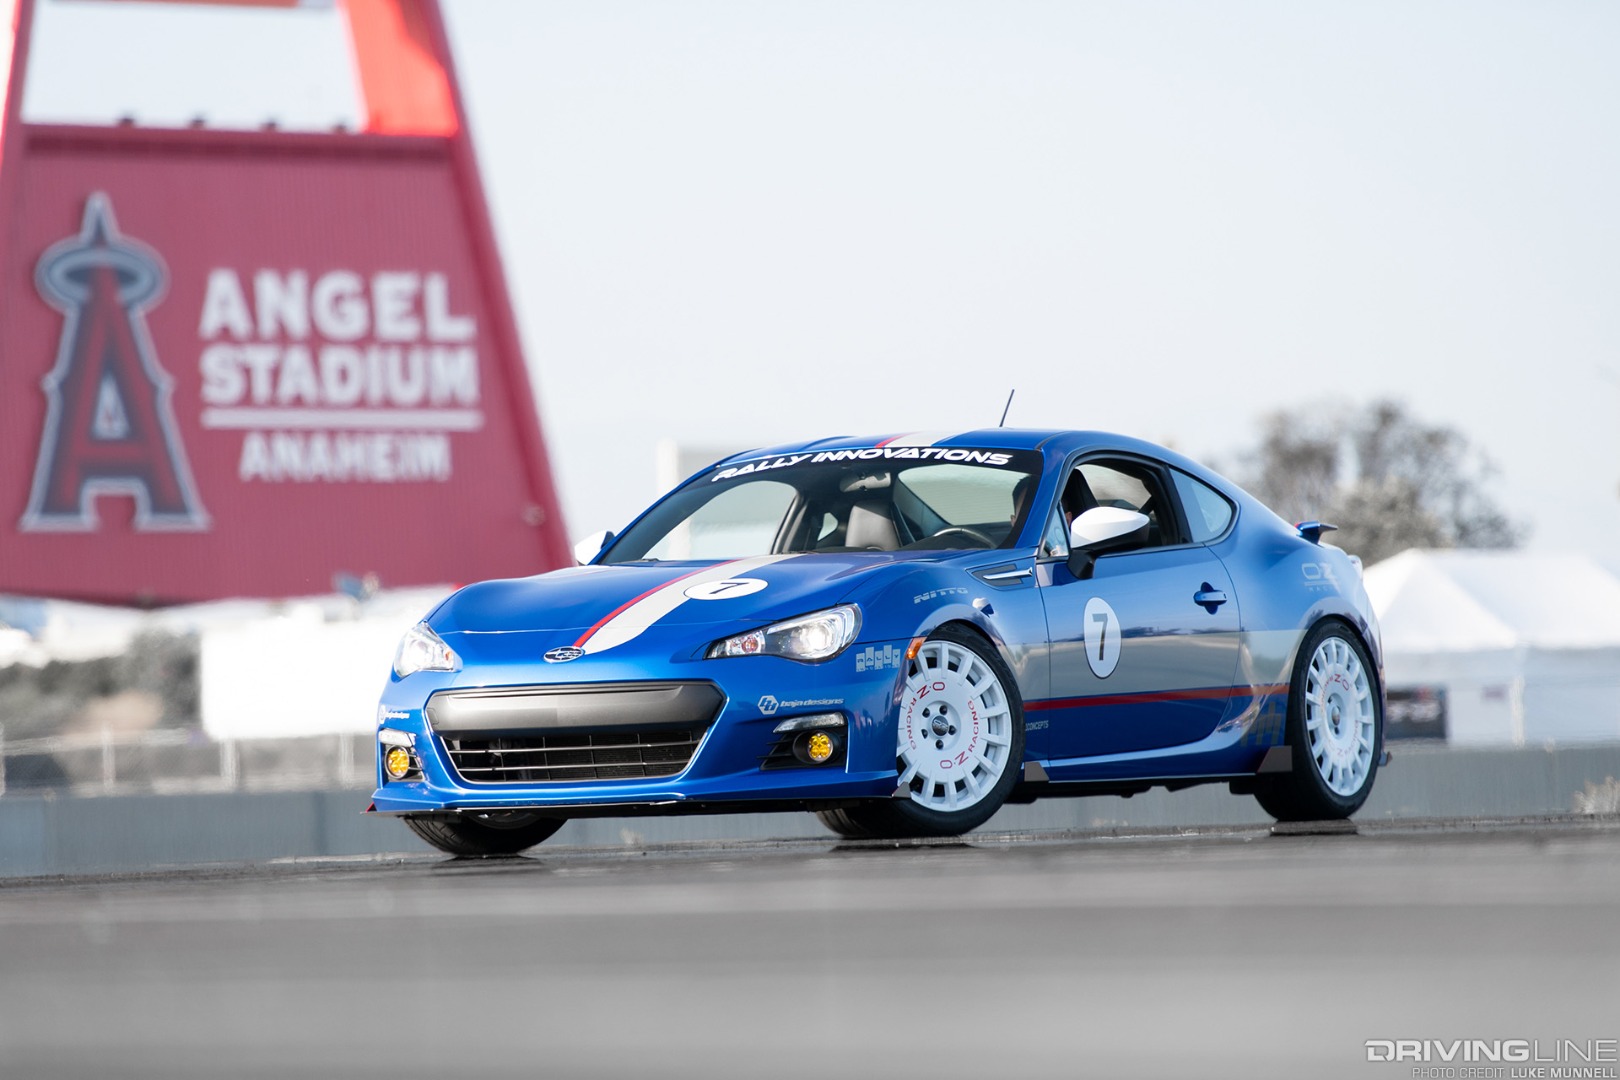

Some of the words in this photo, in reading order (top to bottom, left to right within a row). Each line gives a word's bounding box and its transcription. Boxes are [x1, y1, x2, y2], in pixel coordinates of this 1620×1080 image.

[200, 267, 477, 341] ANGEL
[200, 344, 480, 406] STADIUM
[239, 431, 452, 482] ANAHEIM
[711, 453, 813, 482] RALLY
[811, 448, 1014, 466] INNOVATIONS
[708, 582, 750, 595] 7
[913, 587, 969, 605] NITTO
[1092, 612, 1108, 661] 7
[780, 700, 803, 708] baja
[803, 698, 844, 706] designs
[905, 697, 917, 750] RACING
[967, 700, 979, 752] RACING
